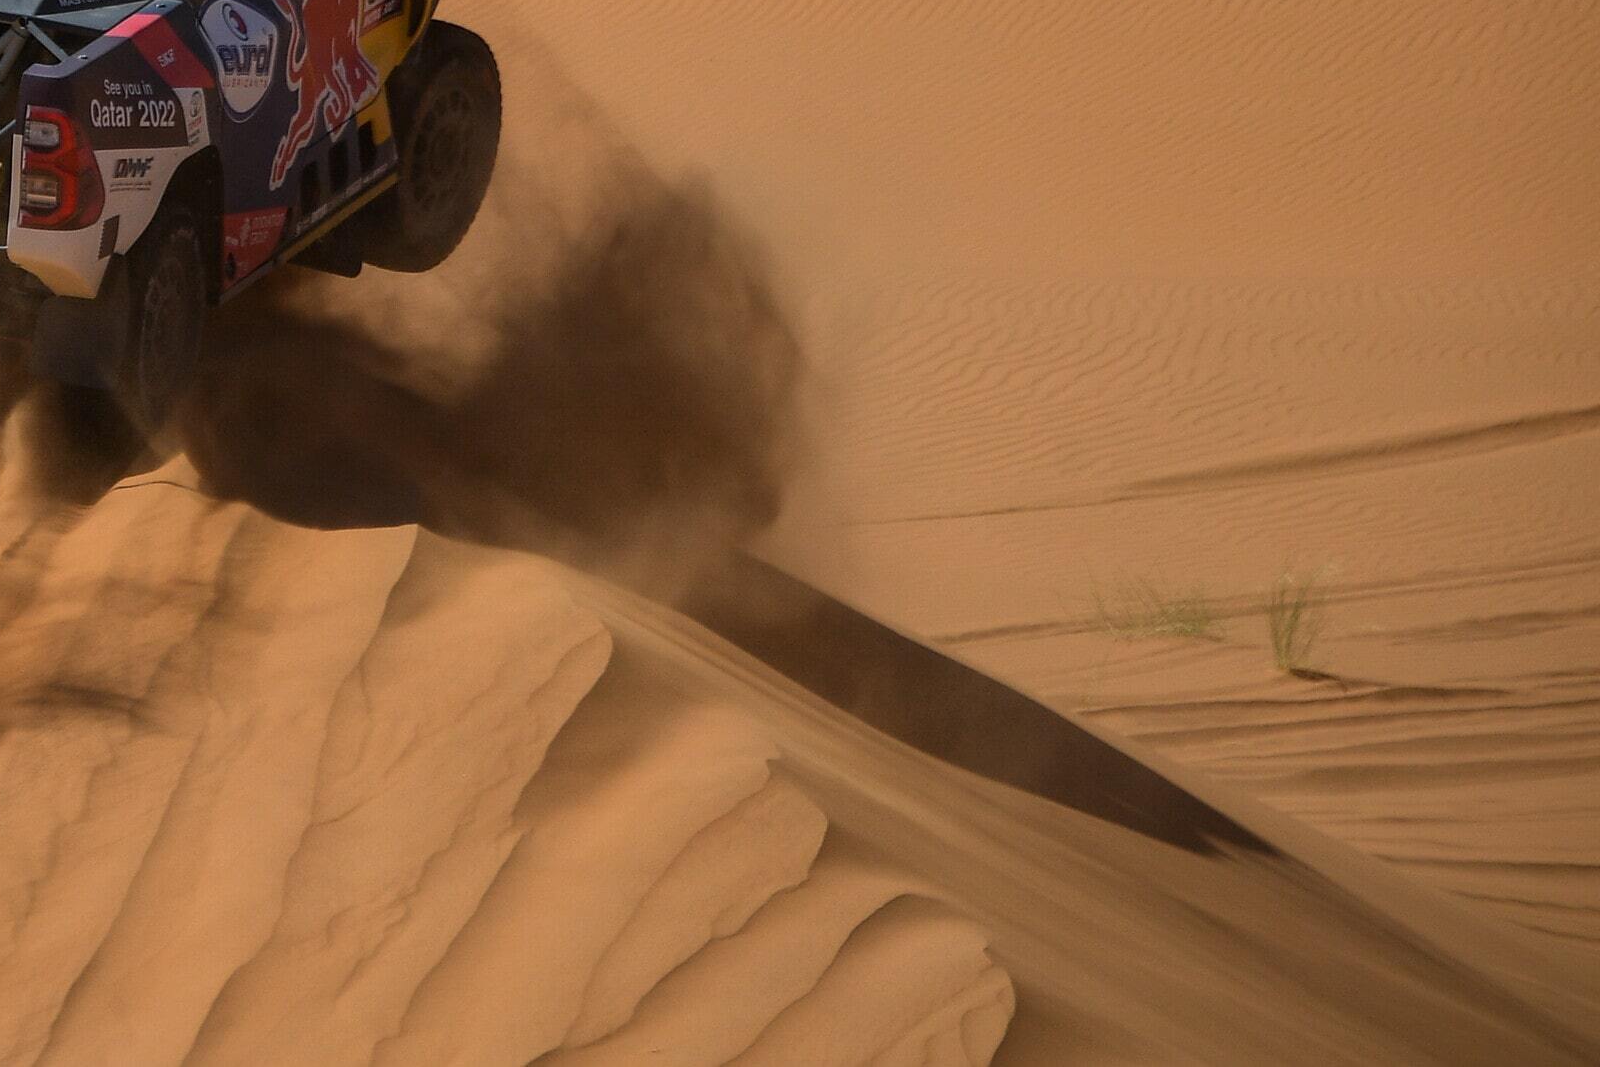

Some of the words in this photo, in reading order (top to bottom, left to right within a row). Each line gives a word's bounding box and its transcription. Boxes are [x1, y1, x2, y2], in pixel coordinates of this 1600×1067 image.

[103, 79, 121, 94] See
[121, 82, 141, 99] you
[142, 80, 153, 95] in
[90, 99, 133, 128] Qatar
[138, 99, 176, 127] 2022
